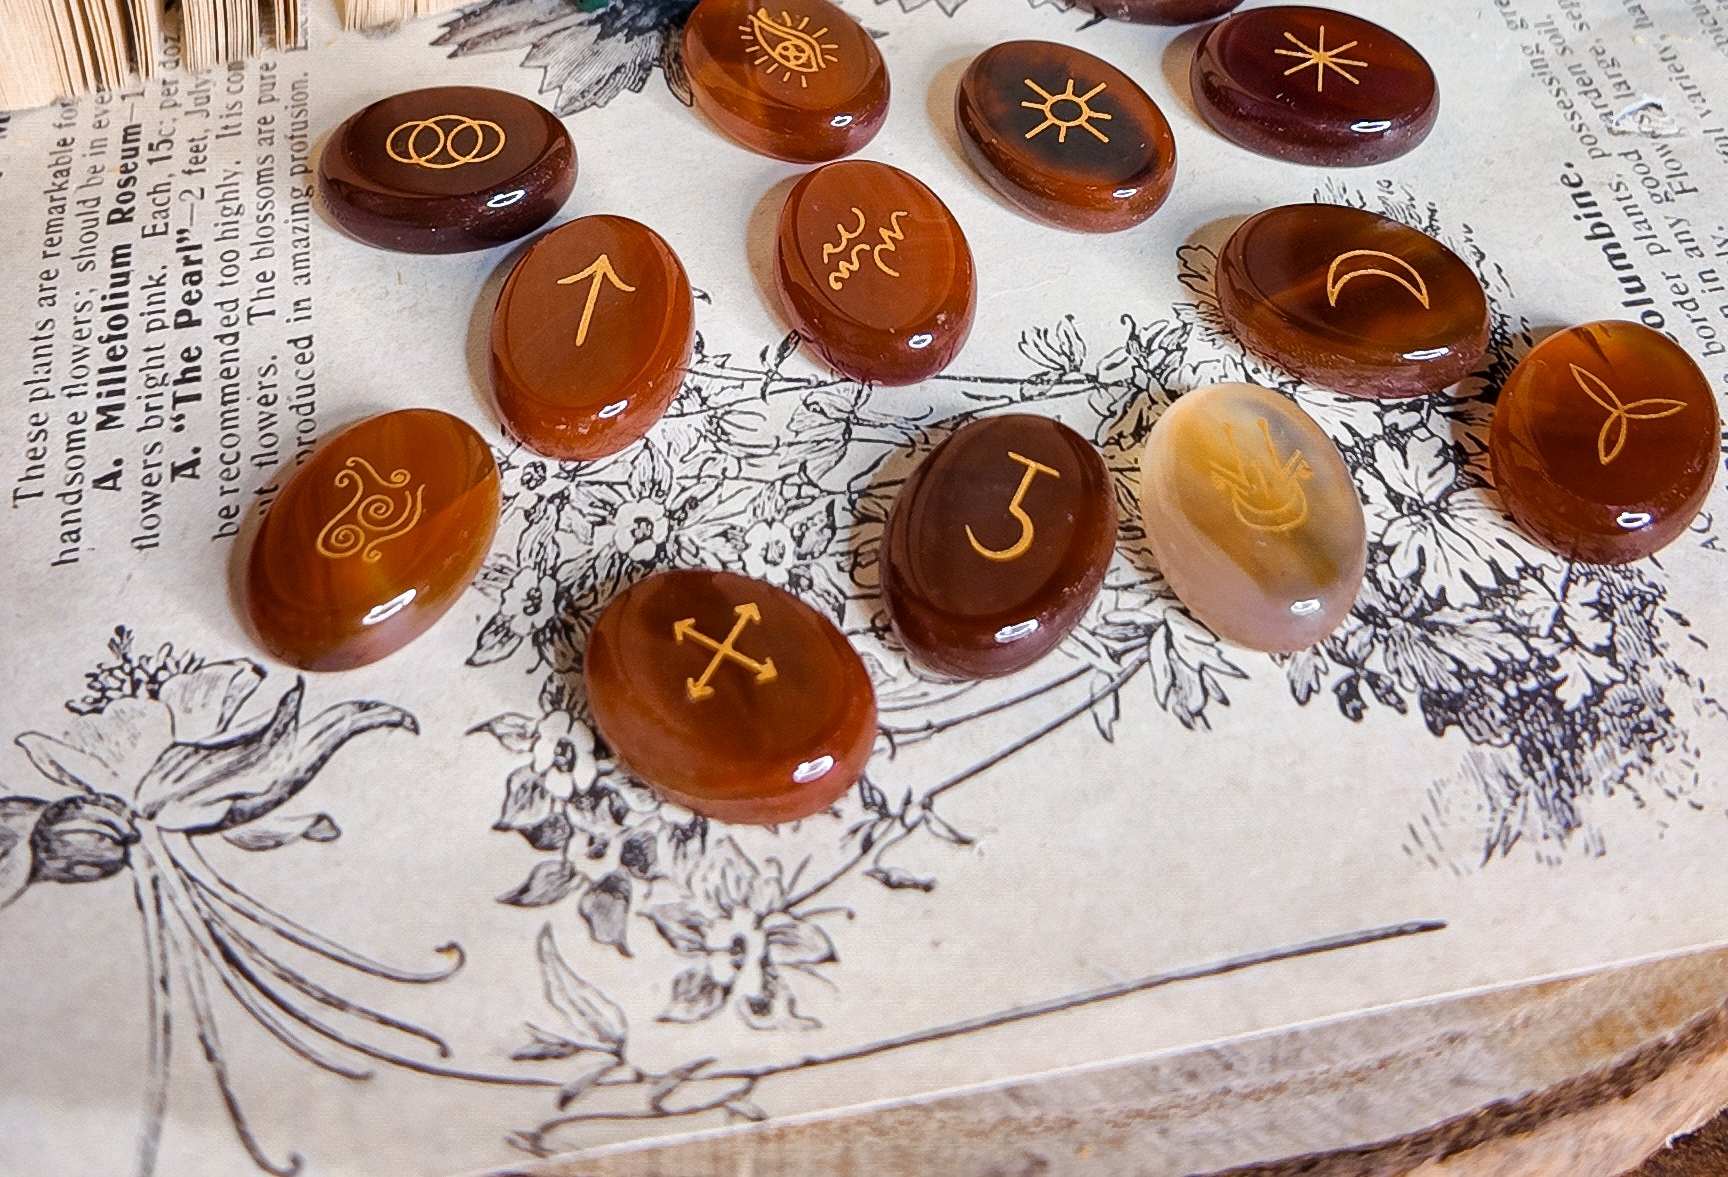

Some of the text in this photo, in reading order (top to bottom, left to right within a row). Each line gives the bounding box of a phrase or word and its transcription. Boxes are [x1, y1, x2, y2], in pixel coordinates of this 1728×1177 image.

[1534, 13, 1574, 57] soil.
[159, 79, 182, 110] per
[256, 61, 280, 105] pure
[1520, 43, 1612, 159] possessing
[82, 137, 108, 158] in
[181, 129, 214, 175] feet,
[256, 115, 275, 147] are
[284, 72, 314, 177] profusion.
[43, 137, 75, 259] remarkable
[75, 164, 105, 189] be
[141, 174, 174, 239] Each,
[214, 160, 245, 242] highly.
[250, 154, 275, 261] blossoms
[1617, 149, 1676, 204] good
[70, 196, 101, 272] should
[216, 249, 240, 287] too
[284, 184, 314, 285] amazing
[1560, 162, 1678, 344] olumbine.
[1664, 215, 1705, 258] any
[37, 269, 60, 307] are
[140, 265, 170, 333] pink.
[246, 270, 276, 325] The
[286, 297, 312, 323] in
[1661, 271, 1726, 357] border
[1698, 269, 1725, 293] in
[23, 318, 56, 403] plants
[60, 288, 97, 399] flowers;
[96, 243, 132, 431] Millefolium
[136, 343, 170, 432] bright
[212, 297, 240, 496] recommended
[250, 355, 278, 469] flowers.
[12, 413, 49, 509] These
[50, 411, 88, 567] handsome
[92, 457, 124, 491] A.
[170, 447, 202, 483] A.
[130, 441, 164, 551] flowers
[211, 505, 240, 542] be
